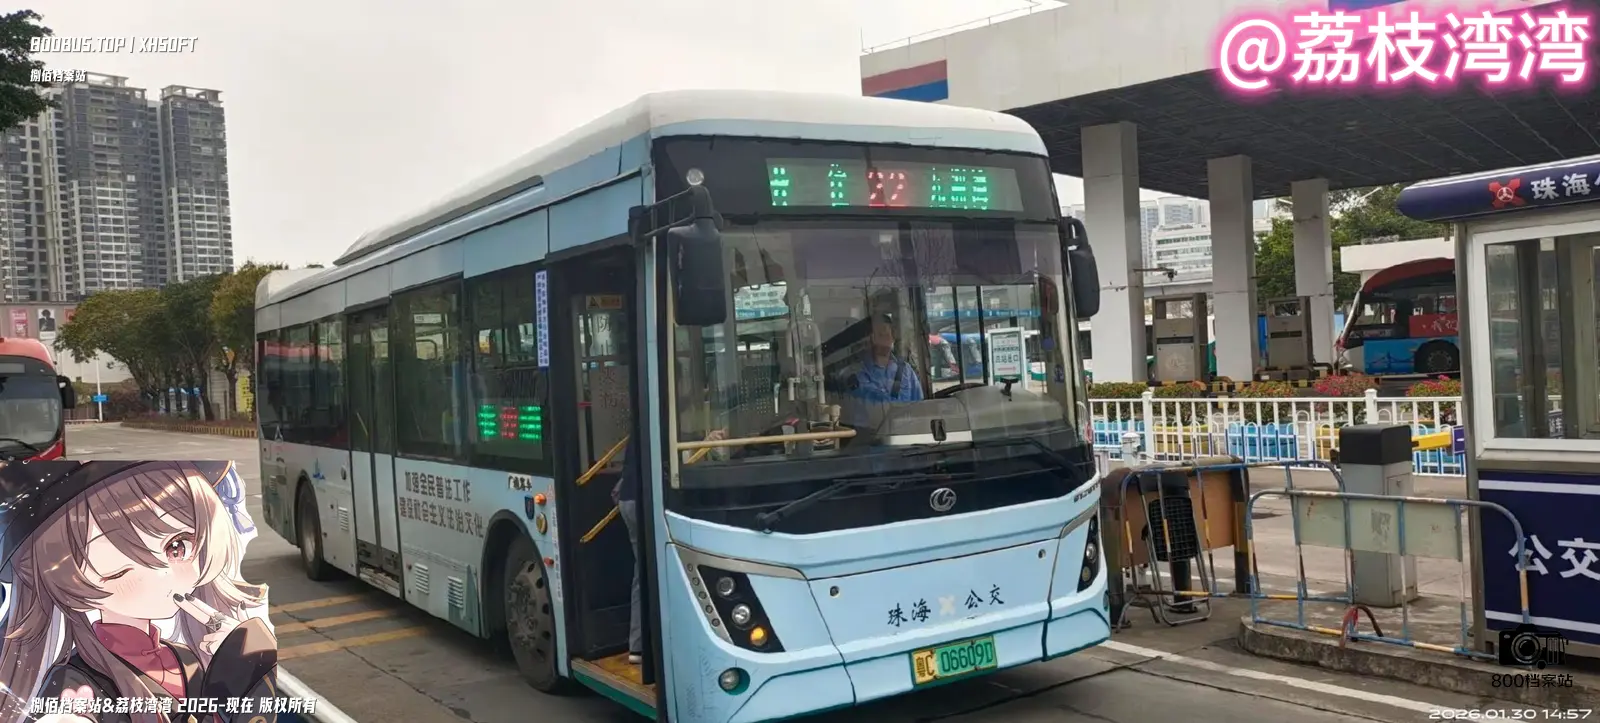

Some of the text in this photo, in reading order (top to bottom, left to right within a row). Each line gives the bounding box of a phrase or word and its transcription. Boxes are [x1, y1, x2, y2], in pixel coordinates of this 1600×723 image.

[1530, 173, 1600, 200] 珠海
[887, 584, 1004, 627] 珠海 公交
